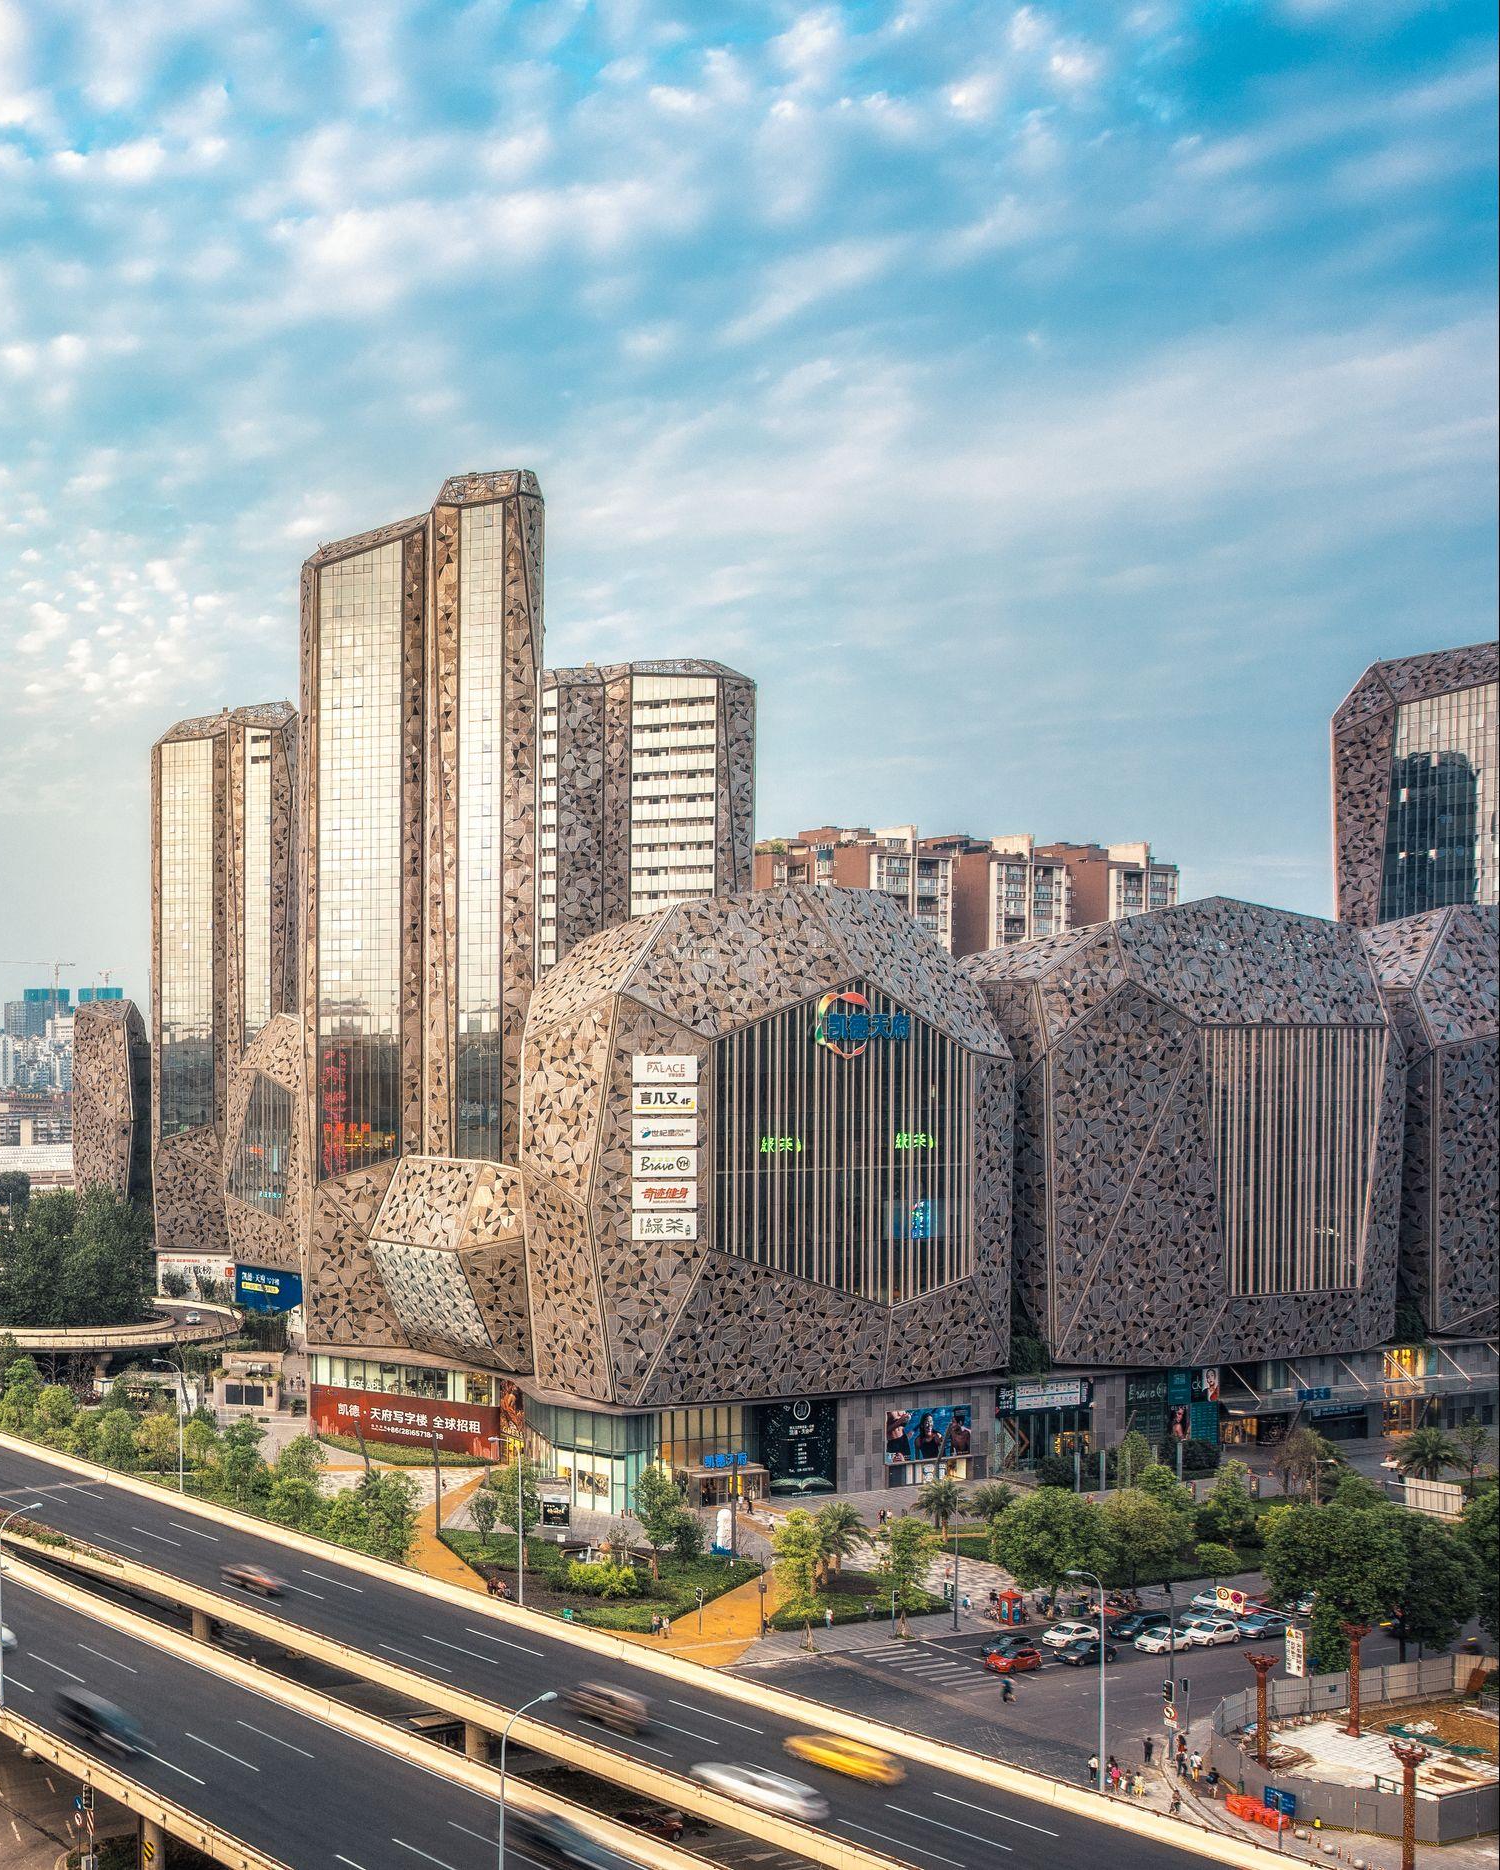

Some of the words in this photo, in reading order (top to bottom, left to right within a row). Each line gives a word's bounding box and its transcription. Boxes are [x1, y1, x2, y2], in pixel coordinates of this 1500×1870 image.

[827, 1012, 911, 1041] 凯德天府
[646, 1063, 686, 1073] PALACE
[640, 1092, 678, 1105] 言几又
[640, 1156, 674, 1172] Bravo
[641, 1187, 689, 1203] 奇迹健身
[337, 1402, 428, 1428] 凯德·天府写字楼
[432, 1415, 481, 1434] 全球招租
